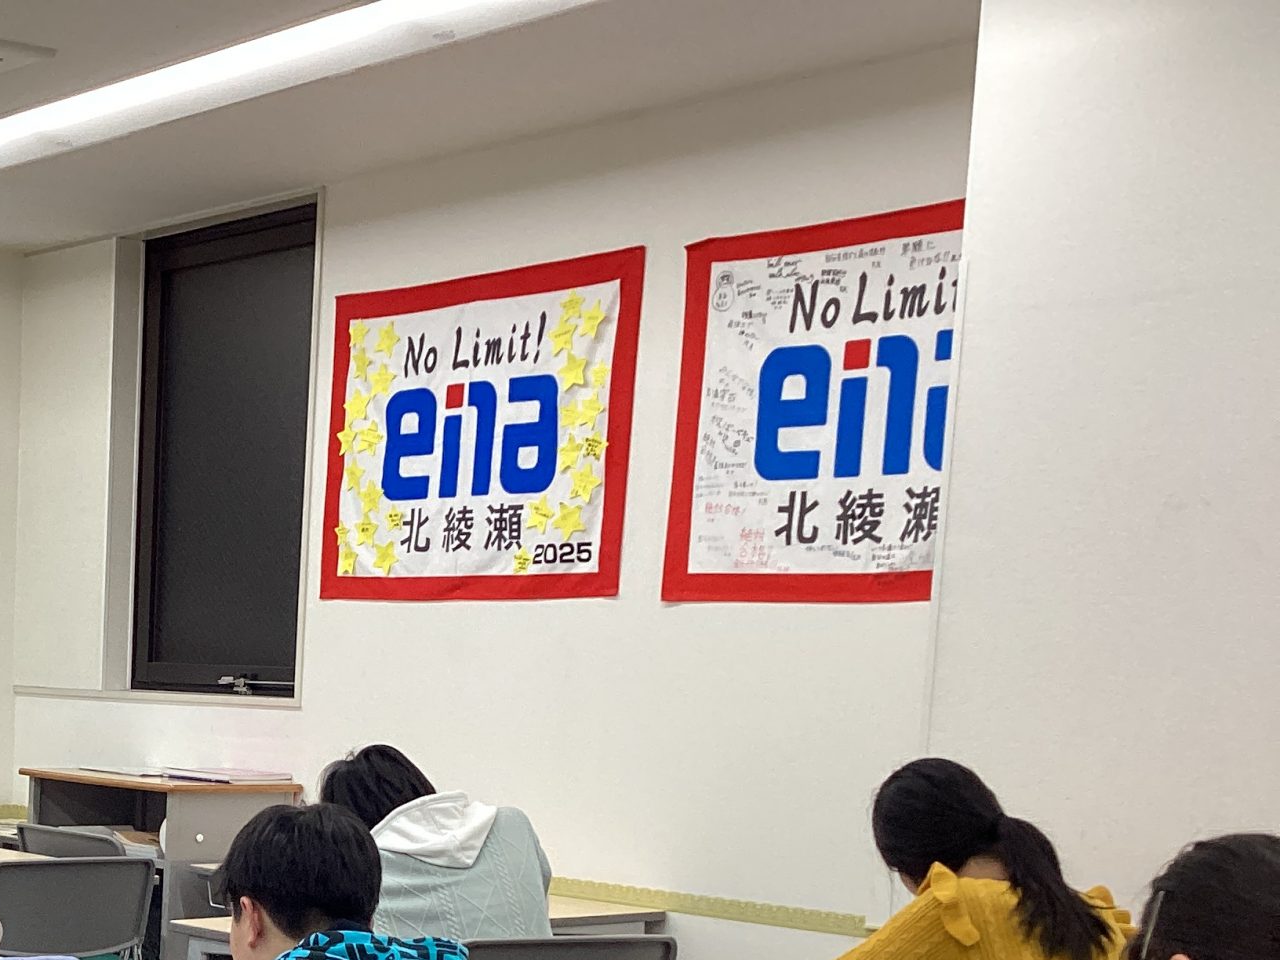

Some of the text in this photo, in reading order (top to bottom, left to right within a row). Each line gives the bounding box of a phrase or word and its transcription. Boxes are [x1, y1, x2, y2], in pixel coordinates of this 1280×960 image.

[789, 278, 841, 333] No
[404, 311, 547, 378] No Limit!
[400, 503, 524, 553] 北綾瀬
[532, 541, 593, 564] 2025
